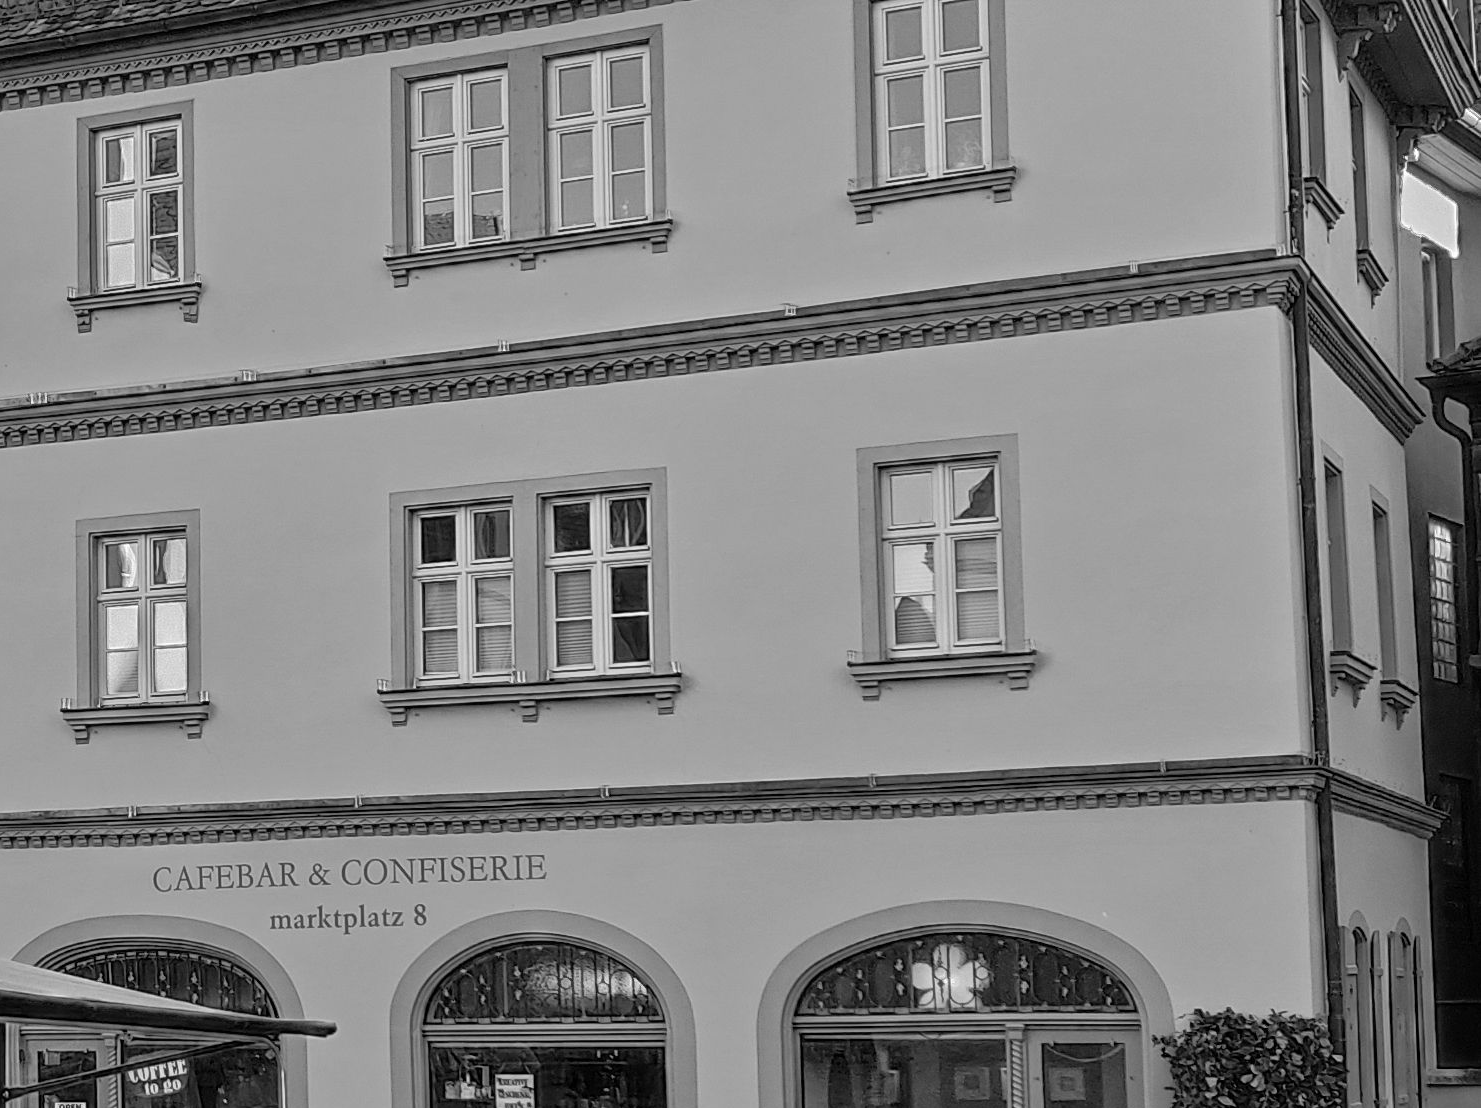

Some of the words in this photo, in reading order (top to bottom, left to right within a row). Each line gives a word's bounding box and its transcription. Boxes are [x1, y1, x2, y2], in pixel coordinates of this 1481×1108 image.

[152, 862, 300, 893] CAFEBAR
[308, 863, 331, 886] &
[341, 854, 547, 886] CONFISERIE
[270, 904, 404, 935] marktplatz
[414, 904, 427, 926] 8
[127, 1058, 188, 1084] COFFEE
[163, 1078, 182, 1094] go
